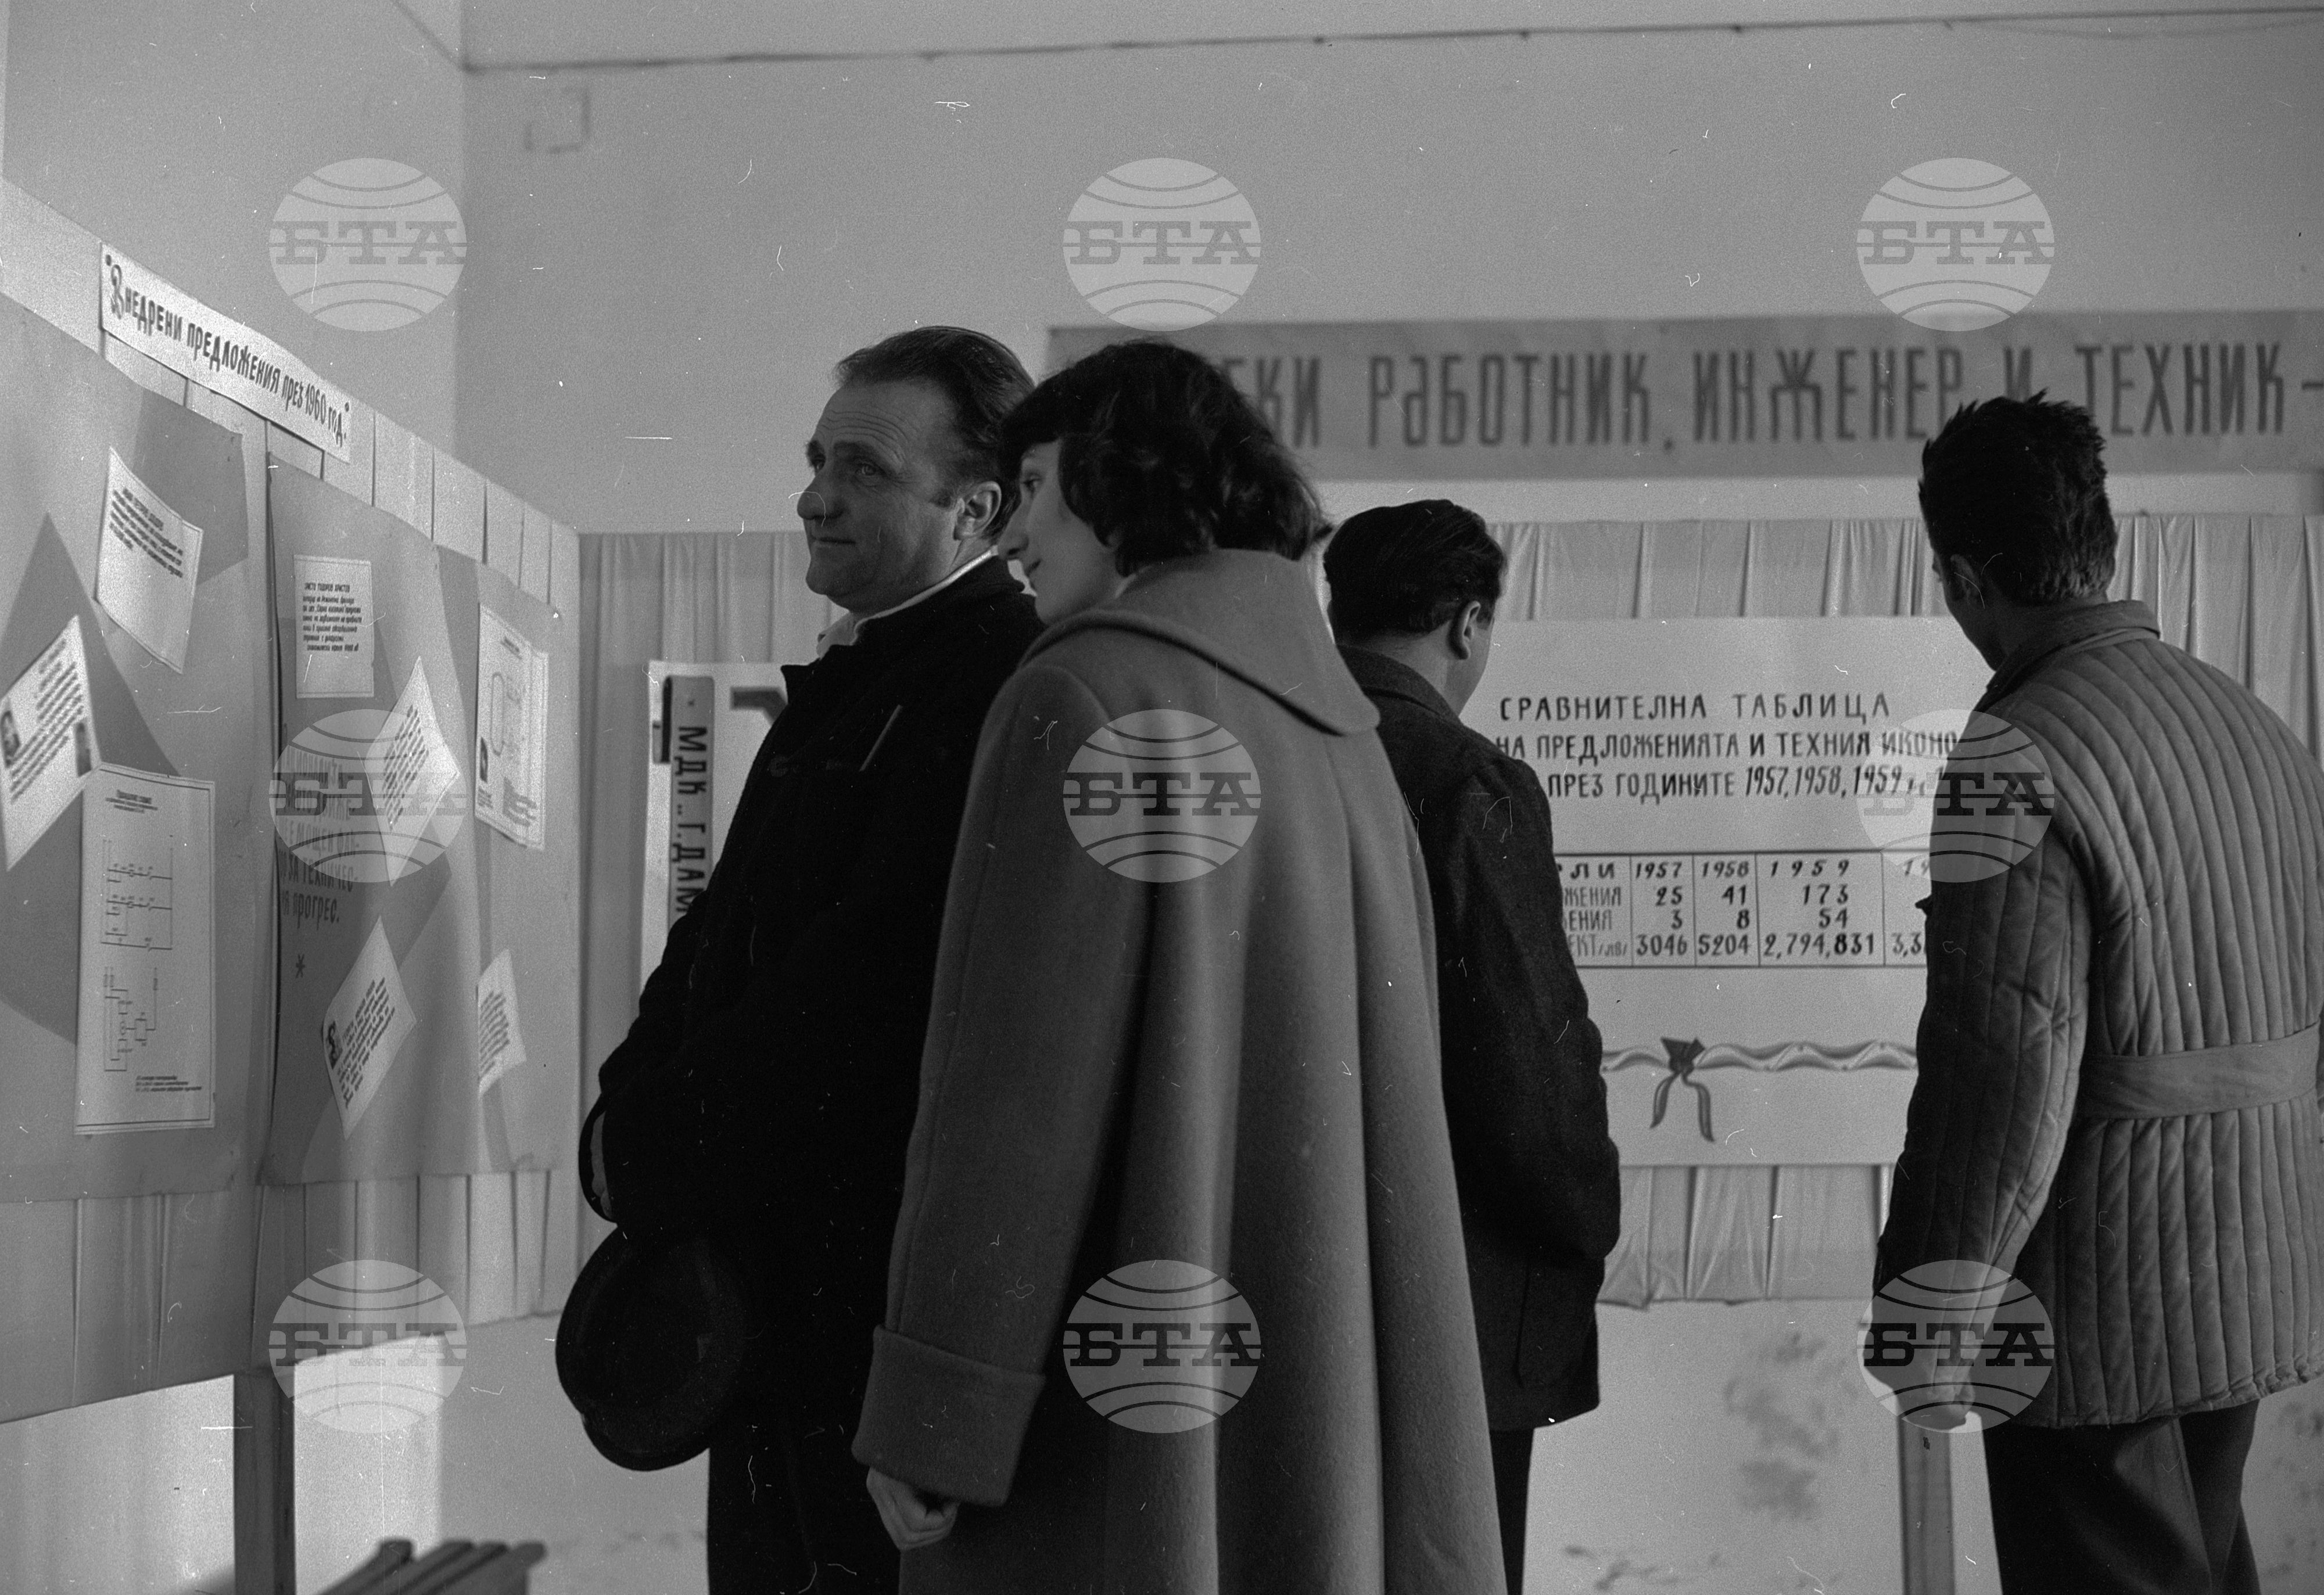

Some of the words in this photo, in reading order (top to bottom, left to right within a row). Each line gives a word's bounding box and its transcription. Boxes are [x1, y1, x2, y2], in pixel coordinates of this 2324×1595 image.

[187, 322, 281, 394] ПРЕДЛОЖЕНИЯ
[281, 375, 304, 411] ПРЕЗ
[305, 383, 327, 425] 1960
[1223, 355, 1322, 448] КИ
[1692, 347, 1964, 443] ИНЖЕНЕР
[1500, 694, 1707, 721] СРАВНИТЕЛНА
[1733, 692, 1889, 725] ТАБЛИЦА
[674, 726, 708, 795] МДК
[1495, 734, 1526, 758] НА
[1537, 732, 1740, 767] ПРЕДЛОЖЕНИЯТА
[1749, 732, 1764, 757] И
[1775, 731, 1871, 757] ТЕХНИЯ
[1548, 773, 1604, 798] ПРЕЗ
[1615, 771, 1735, 806] ГОДИНИТЕ
[1557, 861, 1615, 880] ЛИ
[1636, 861, 1682, 879] 1957
[1702, 861, 1749, 878] 1958
[1771, 858, 1849, 877] 1959
[1655, 886, 1683, 907] 25
[1721, 884, 1746, 906] 41
[1802, 883, 1849, 905] 173
[1563, 908, 1612, 931] ЕНИЯ
[1670, 908, 1683, 930] 3
[1737, 908, 1750, 930] 8
[1819, 907, 1848, 929] 54
[1636, 933, 1687, 957] 3046
[1698, 933, 1749, 956] 5204
[1763, 932, 1874, 960] 2,794,831
[1891, 932, 1927, 958] 3,3
